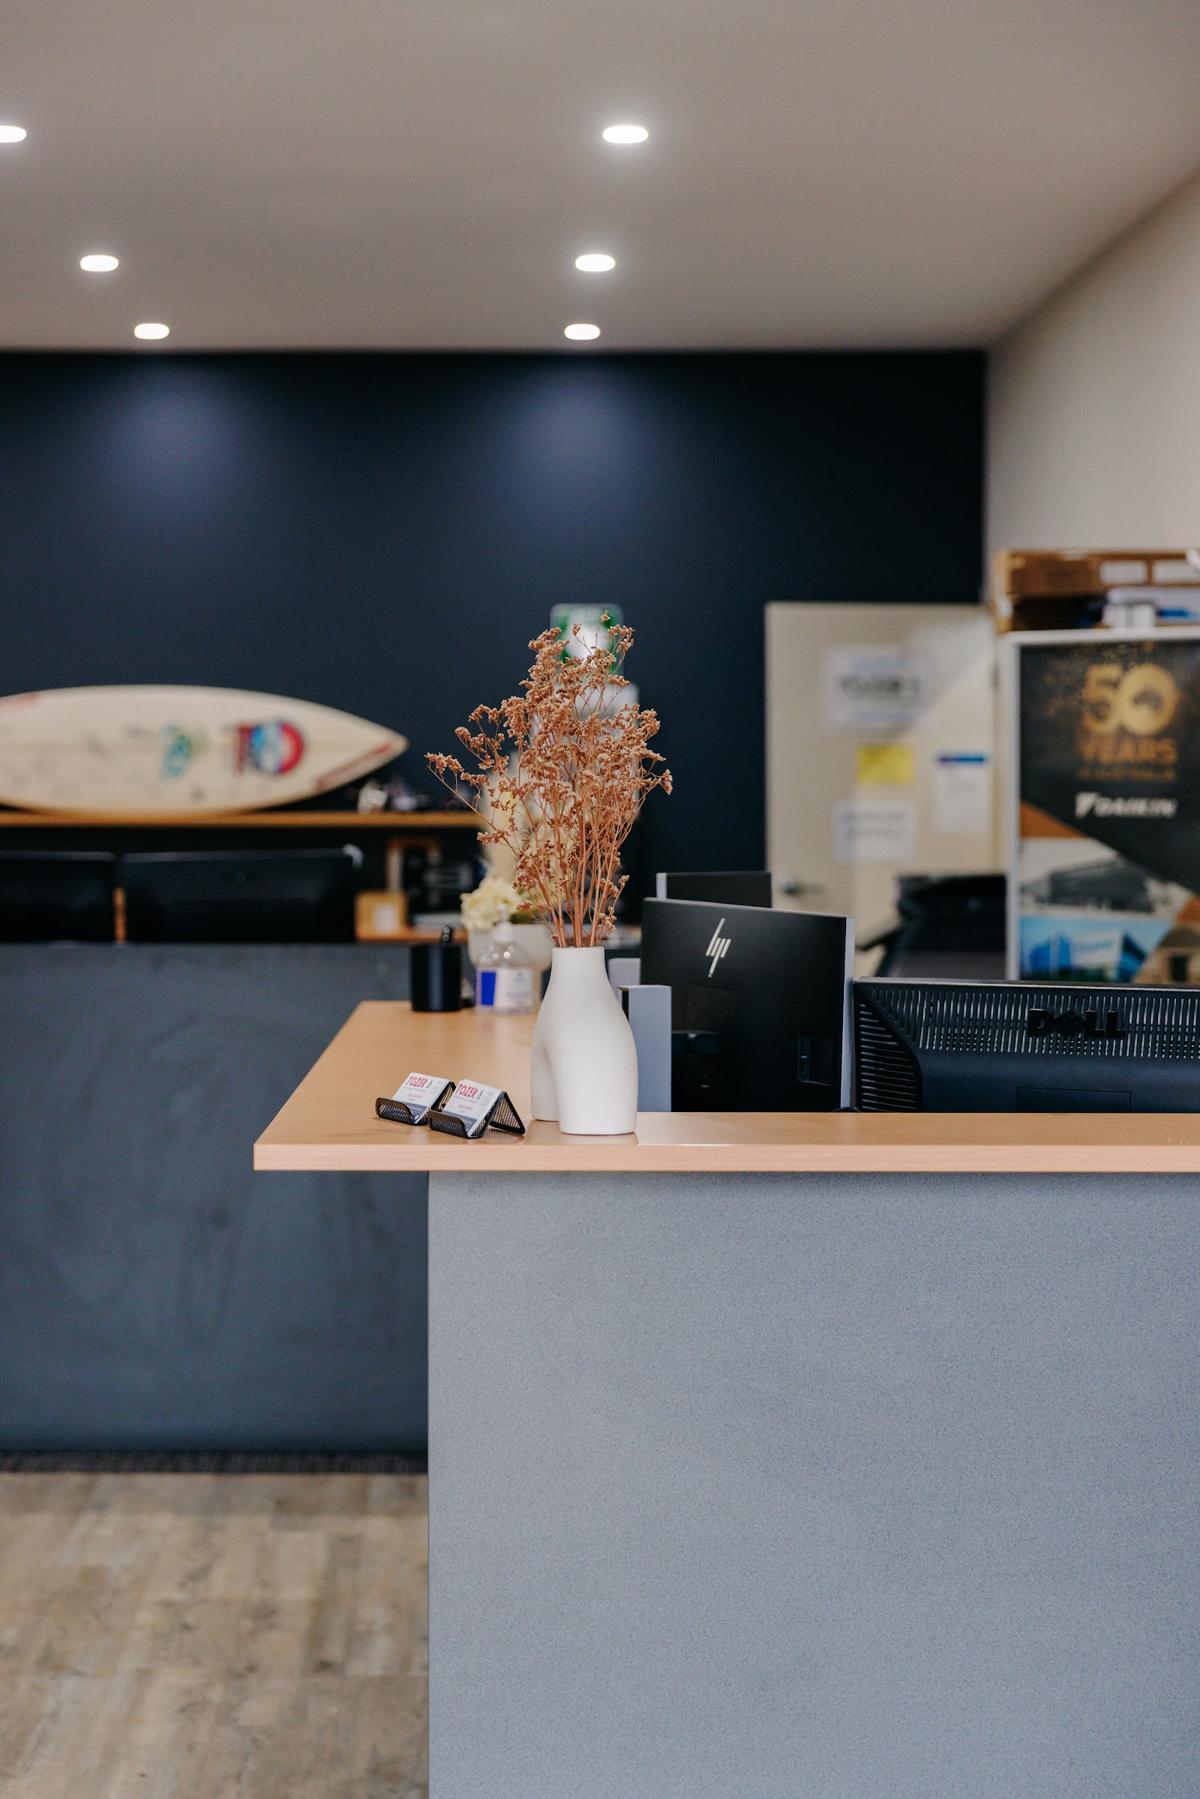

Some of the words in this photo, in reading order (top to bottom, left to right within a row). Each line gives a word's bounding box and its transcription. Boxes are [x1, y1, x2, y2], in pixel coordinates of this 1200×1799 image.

[1081, 662, 1179, 736] 50
[1094, 796, 1177, 817] DAIKIN
[1026, 1008, 1126, 1040] DELL
[406, 1075, 427, 1088] TOZER
[456, 1083, 478, 1098] TOZER
